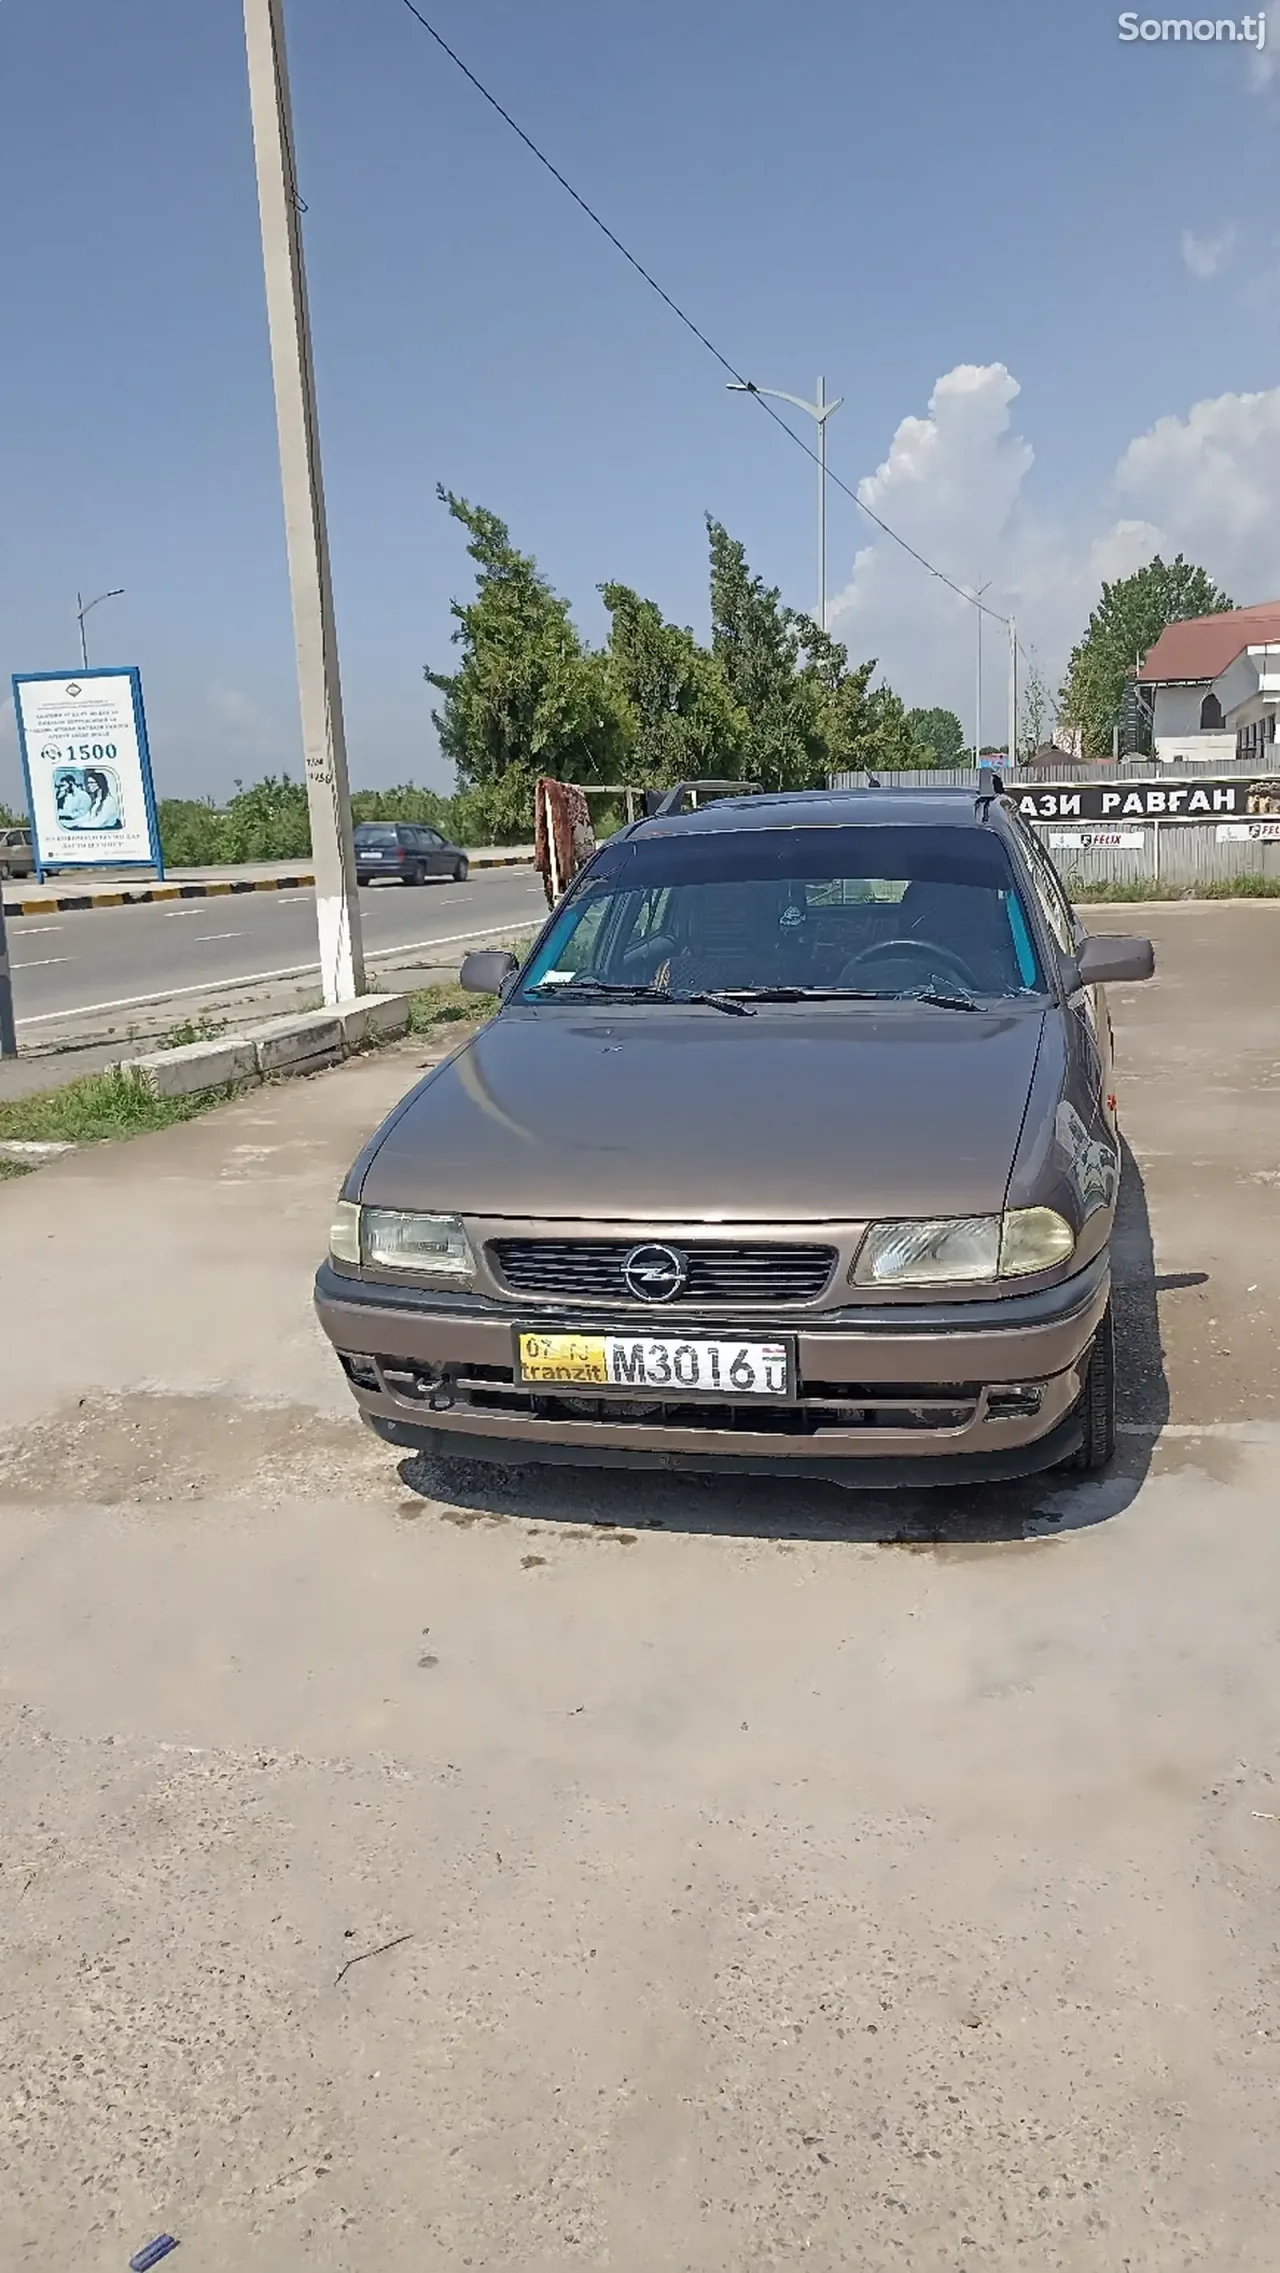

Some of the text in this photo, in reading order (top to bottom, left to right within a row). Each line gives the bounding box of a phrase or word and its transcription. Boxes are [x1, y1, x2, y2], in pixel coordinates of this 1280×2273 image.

[66, 743, 117, 761] 1500
[1019, 795, 1081, 816] АЗИ
[1093, 834, 1122, 844] FELIX
[521, 1362, 602, 1382] tranzit
